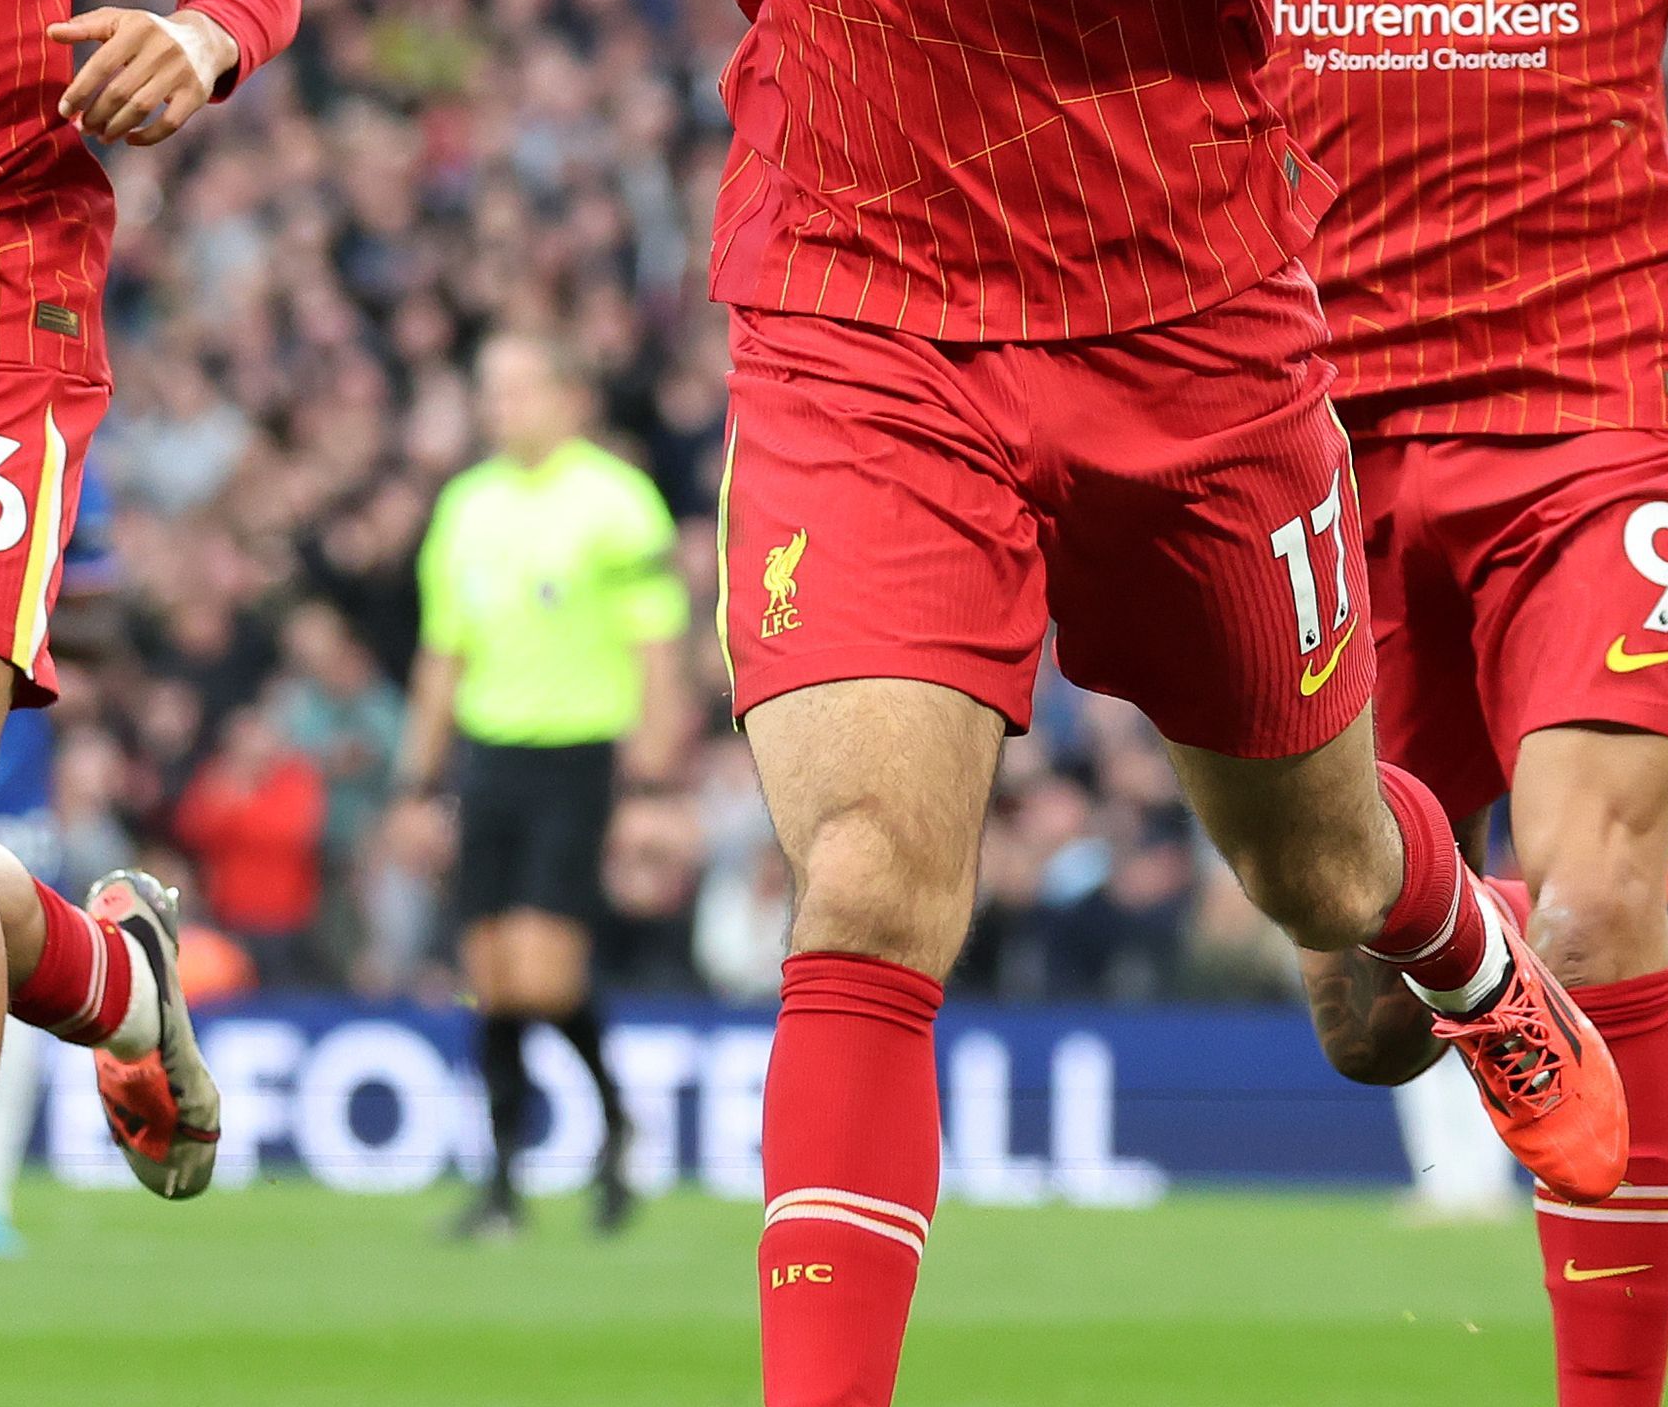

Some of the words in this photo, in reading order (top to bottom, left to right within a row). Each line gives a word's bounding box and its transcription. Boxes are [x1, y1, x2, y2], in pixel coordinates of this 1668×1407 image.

[1303, 48, 1326, 76] by
[1328, 47, 1429, 71] Standard
[1432, 46, 1548, 71] Chartered
[1270, 468, 1350, 656] 17
